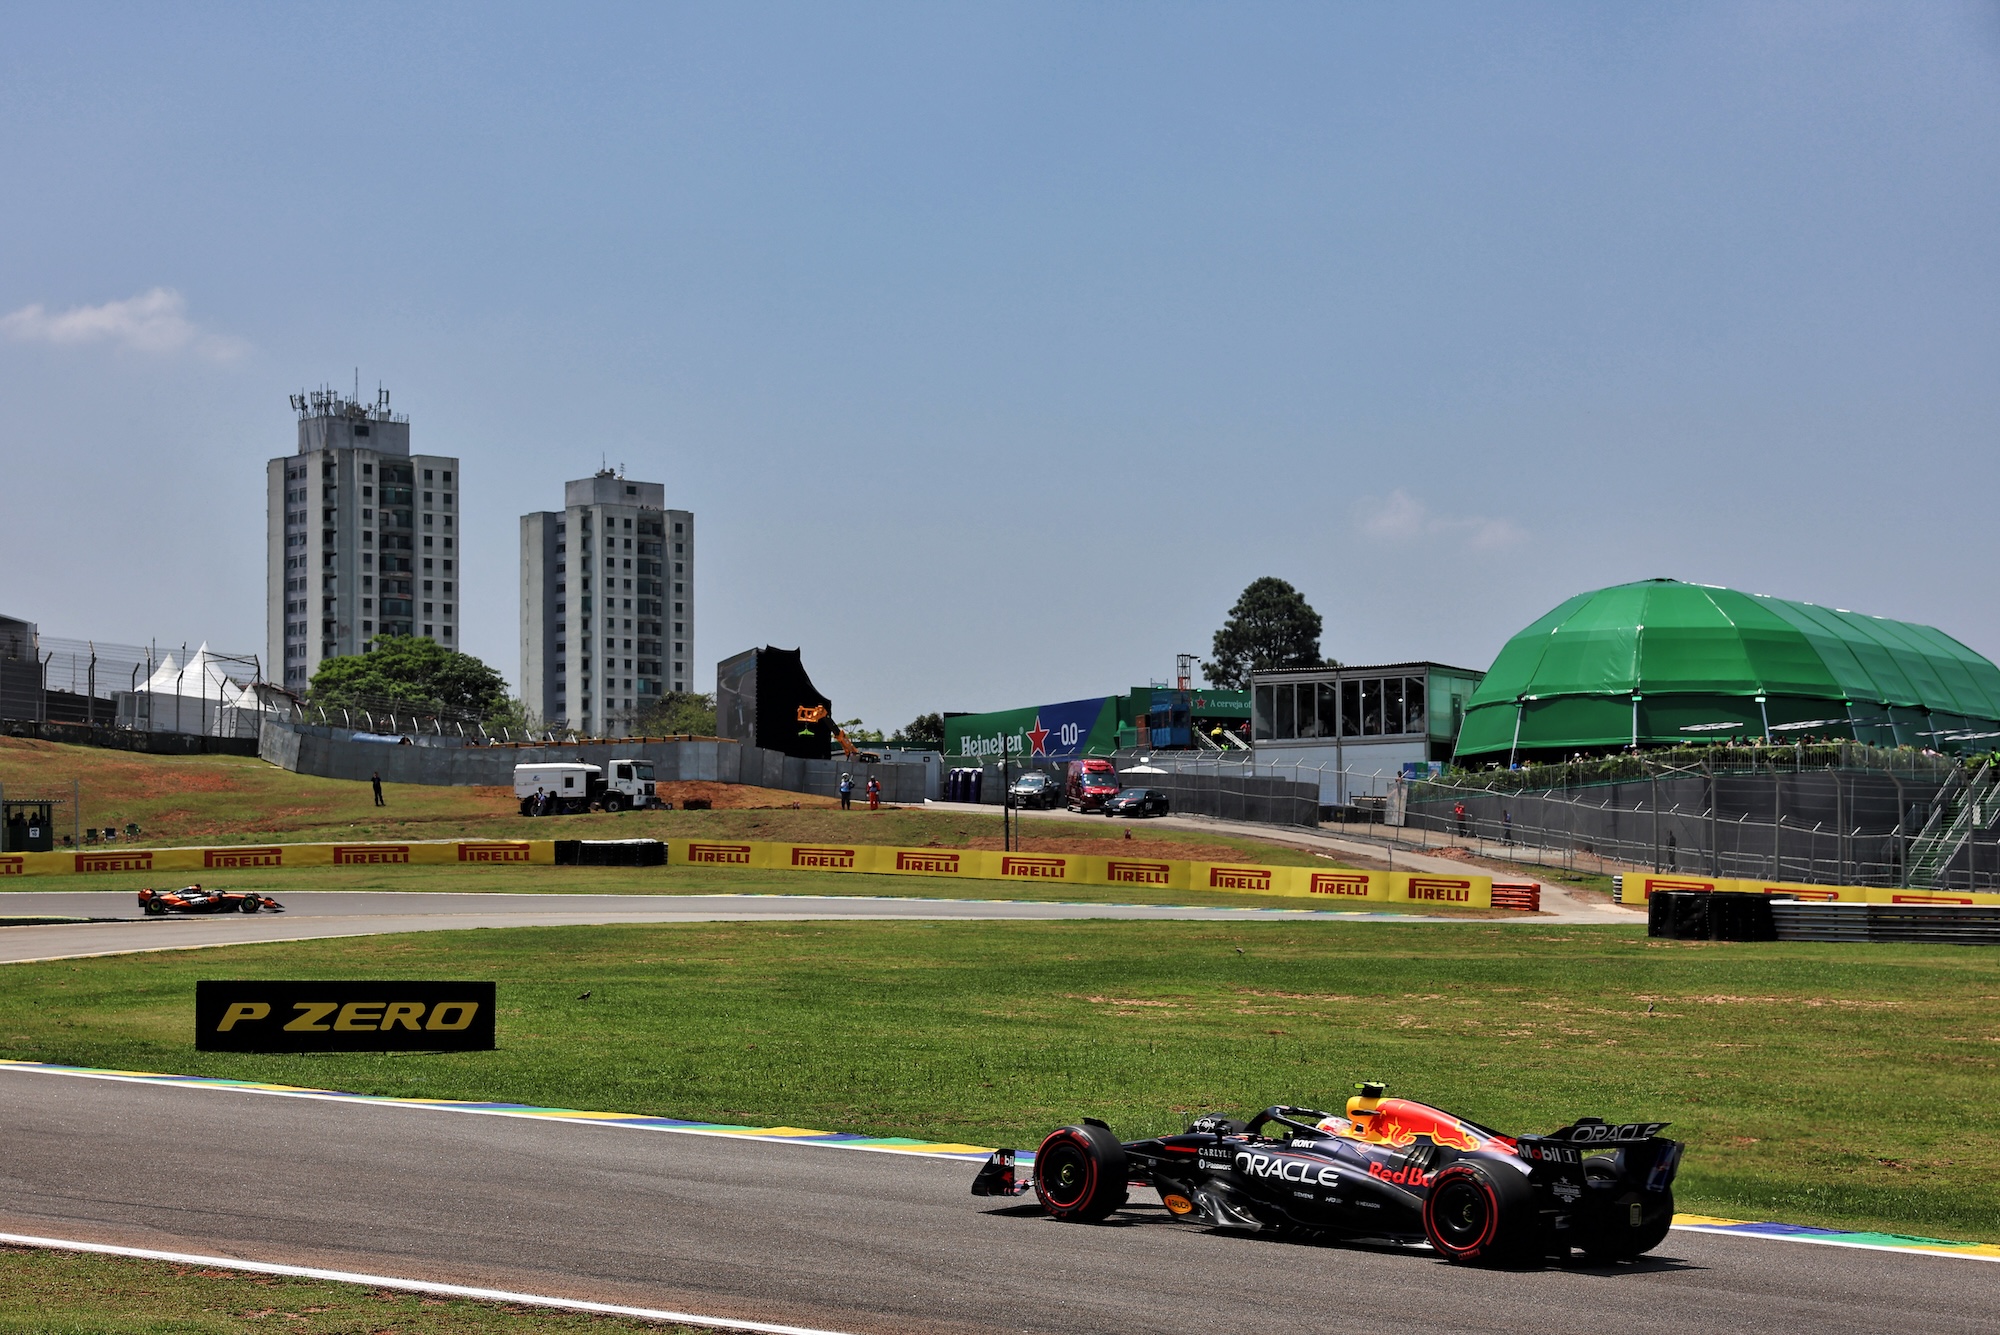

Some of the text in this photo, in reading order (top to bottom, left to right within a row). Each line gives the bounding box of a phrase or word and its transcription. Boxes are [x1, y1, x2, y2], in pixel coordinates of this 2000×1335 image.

[1216, 700, 1243, 710] cerveja
[1060, 722, 1079, 746] 0.0
[961, 732, 1023, 757] Heineken
[75, 853, 153, 872] PIRELLI
[204, 848, 283, 868] PIRELLI
[334, 846, 410, 864] PIRELLI
[458, 843, 530, 862] PIRELLI
[689, 844, 750, 864] PIRELLI
[792, 848, 854, 867] PIRELLI
[897, 851, 960, 873] PIRELLI
[1002, 856, 1065, 878] PIRELLI
[1107, 862, 1170, 884] PIRELLI
[1210, 867, 1271, 891] PIRELLI
[1310, 873, 1370, 896] PIRELLI
[1408, 878, 1471, 902] PIRELLI
[216, 1002, 479, 1032] P ZERO
[1571, 1124, 1661, 1142] ORACLE
[1198, 1147, 1232, 1159] CARLYLE
[1290, 1138, 1318, 1149] ROKT
[1517, 1144, 1562, 1163] Mobil
[992, 1154, 1015, 1167] Mobil
[1235, 1152, 1343, 1188] ORACLE
[1368, 1161, 1431, 1188] Red Bu
